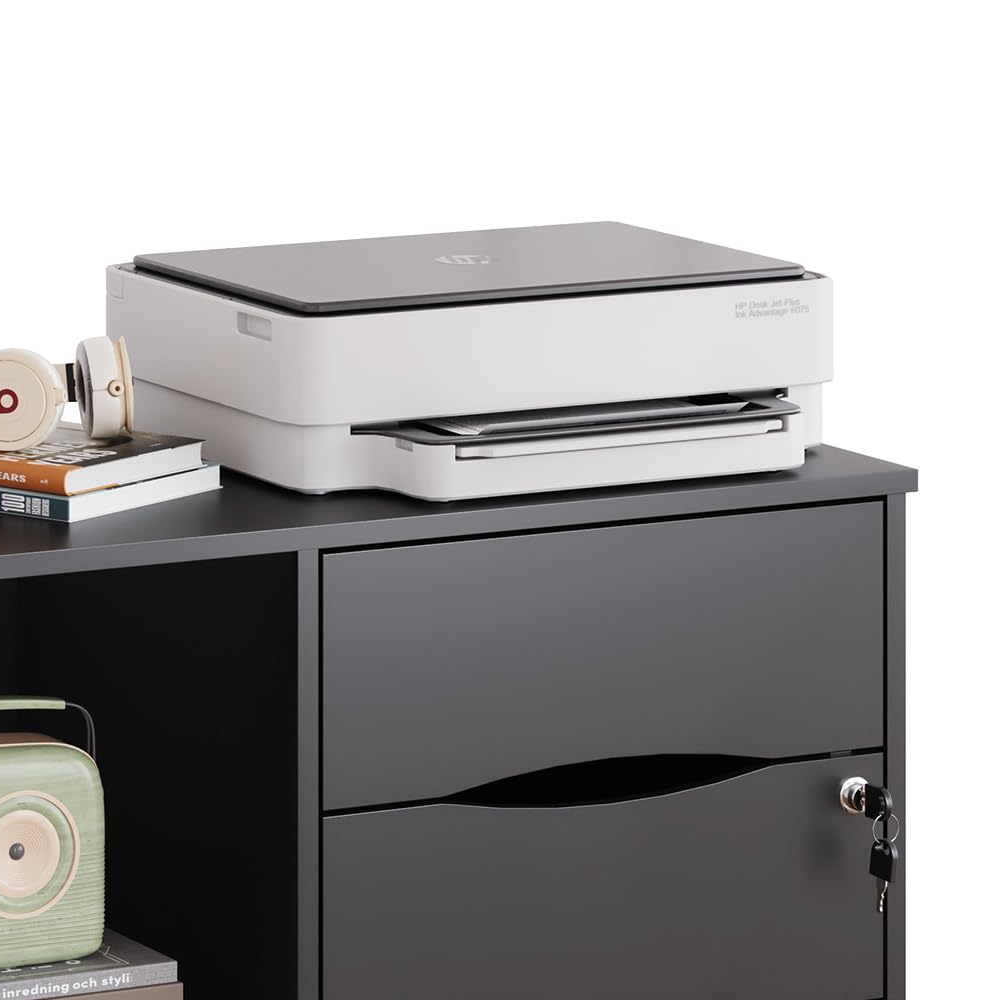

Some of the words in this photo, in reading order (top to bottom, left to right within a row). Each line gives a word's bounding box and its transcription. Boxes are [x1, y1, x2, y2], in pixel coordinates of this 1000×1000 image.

[1, 493, 25, 513] 100
[2, 982, 70, 998] inredning
[73, 977, 97, 990] och
[101, 973, 130, 986] styli
